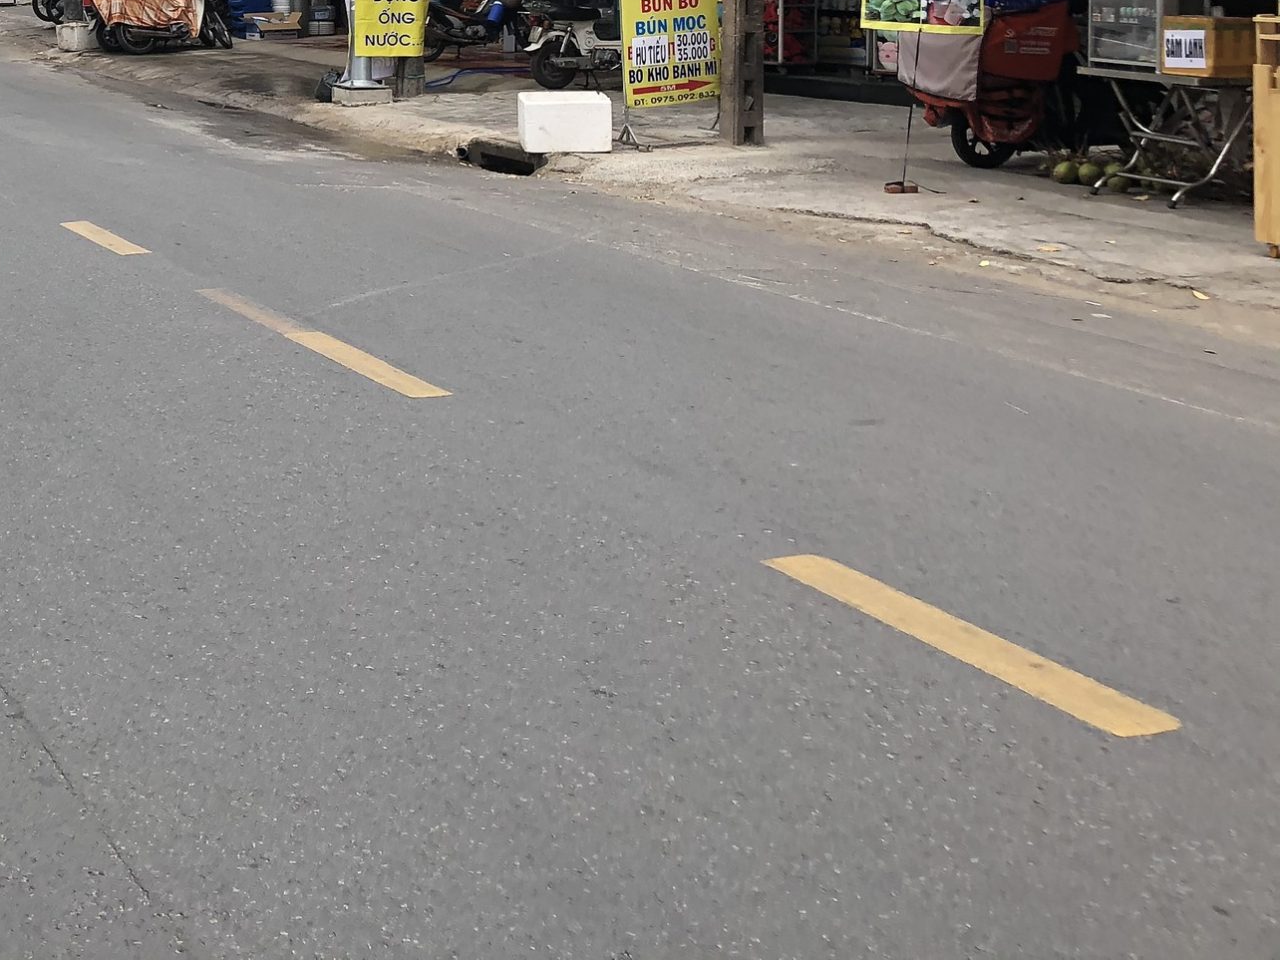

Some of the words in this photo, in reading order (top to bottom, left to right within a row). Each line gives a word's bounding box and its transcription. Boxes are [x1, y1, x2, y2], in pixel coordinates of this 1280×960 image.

[378, 7, 416, 25] ỐNG
[635, 16, 668, 36] BÚN
[673, 14, 707, 34] MỌC
[677, 31, 708, 47] 30.000
[677, 46, 709, 62] 35.000
[647, 65, 670, 83] KHO
